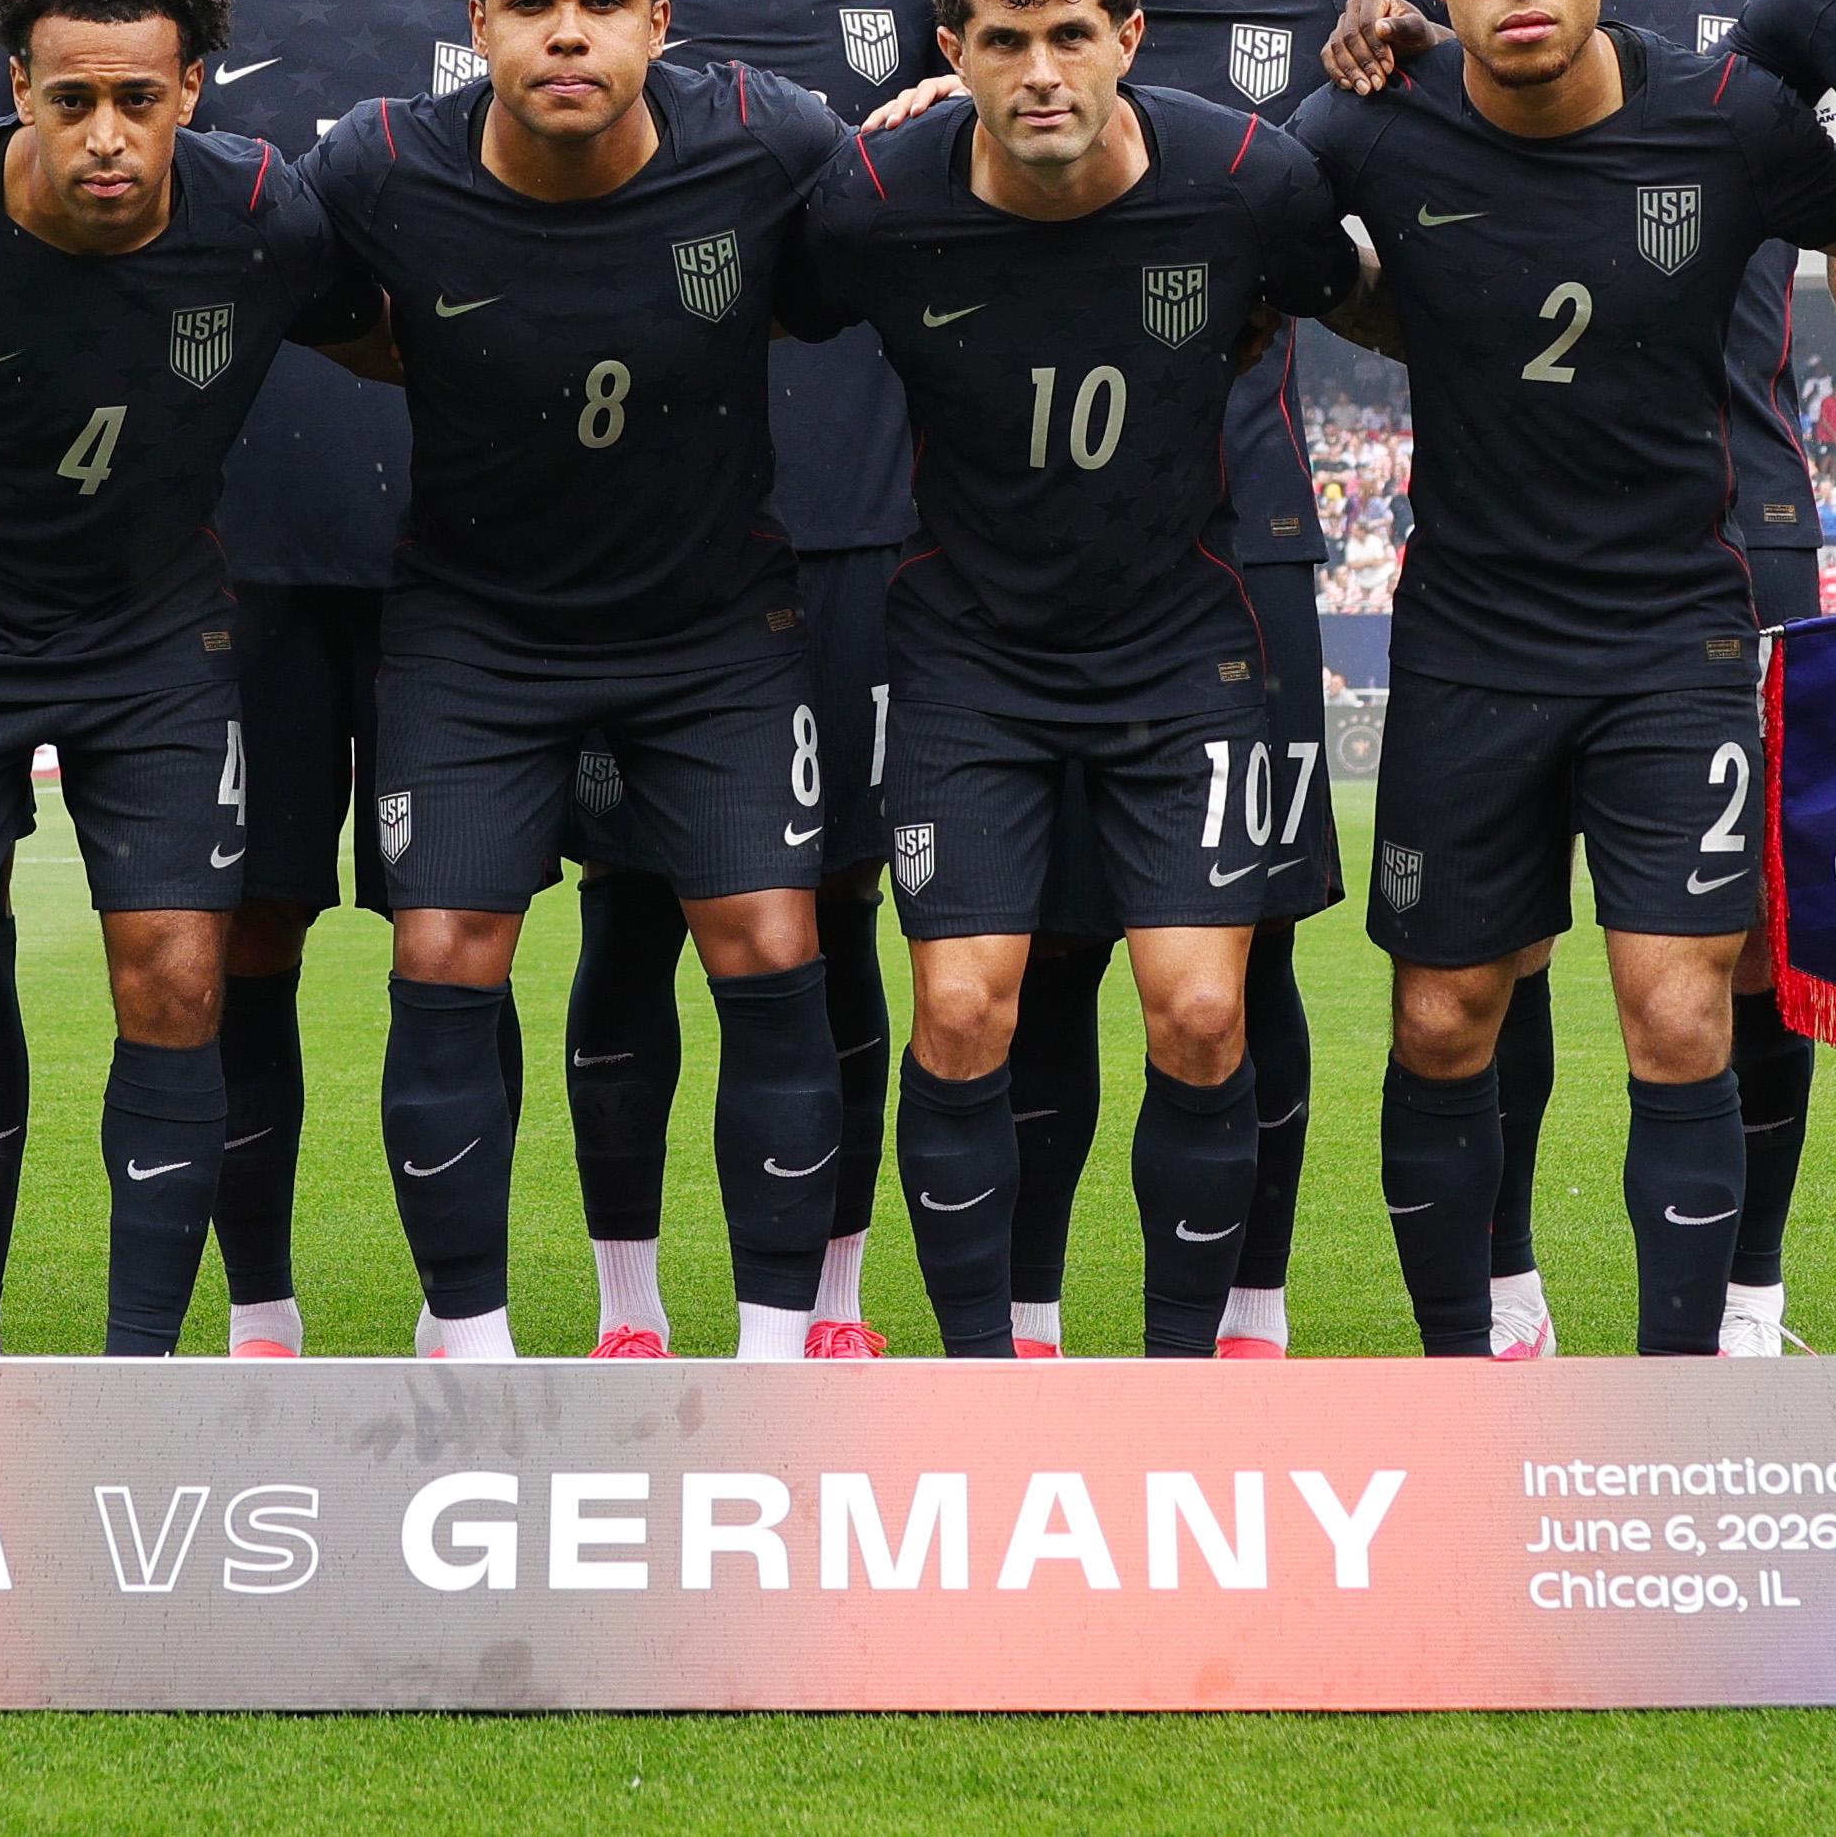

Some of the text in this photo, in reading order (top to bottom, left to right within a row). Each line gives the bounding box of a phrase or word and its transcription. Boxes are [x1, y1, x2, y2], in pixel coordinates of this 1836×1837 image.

[844, 13, 890, 38] USA
[1237, 30, 1286, 61] USA
[1642, 190, 1695, 225] USA
[679, 234, 733, 274] USA
[1149, 269, 1202, 301] USA
[177, 307, 228, 341] USA
[1521, 282, 1593, 384] 2
[578, 360, 631, 448] 8
[1029, 365, 1127, 470] 10
[57, 405, 127, 495] 4
[217, 720, 246, 826] 4
[790, 704, 821, 807] 8
[380, 795, 409, 823] USA
[1699, 741, 1750, 853] 2
[896, 826, 932, 855] USA
[1384, 845, 1420, 874] USA
[93, 1483, 322, 1596] VS
[398, 1467, 1410, 1593] GERMANY
[1526, 1515, 1651, 1553] June
[1664, 1514, 1706, 1557] 6,
[1528, 1569, 1801, 1614] Chicago, IL
